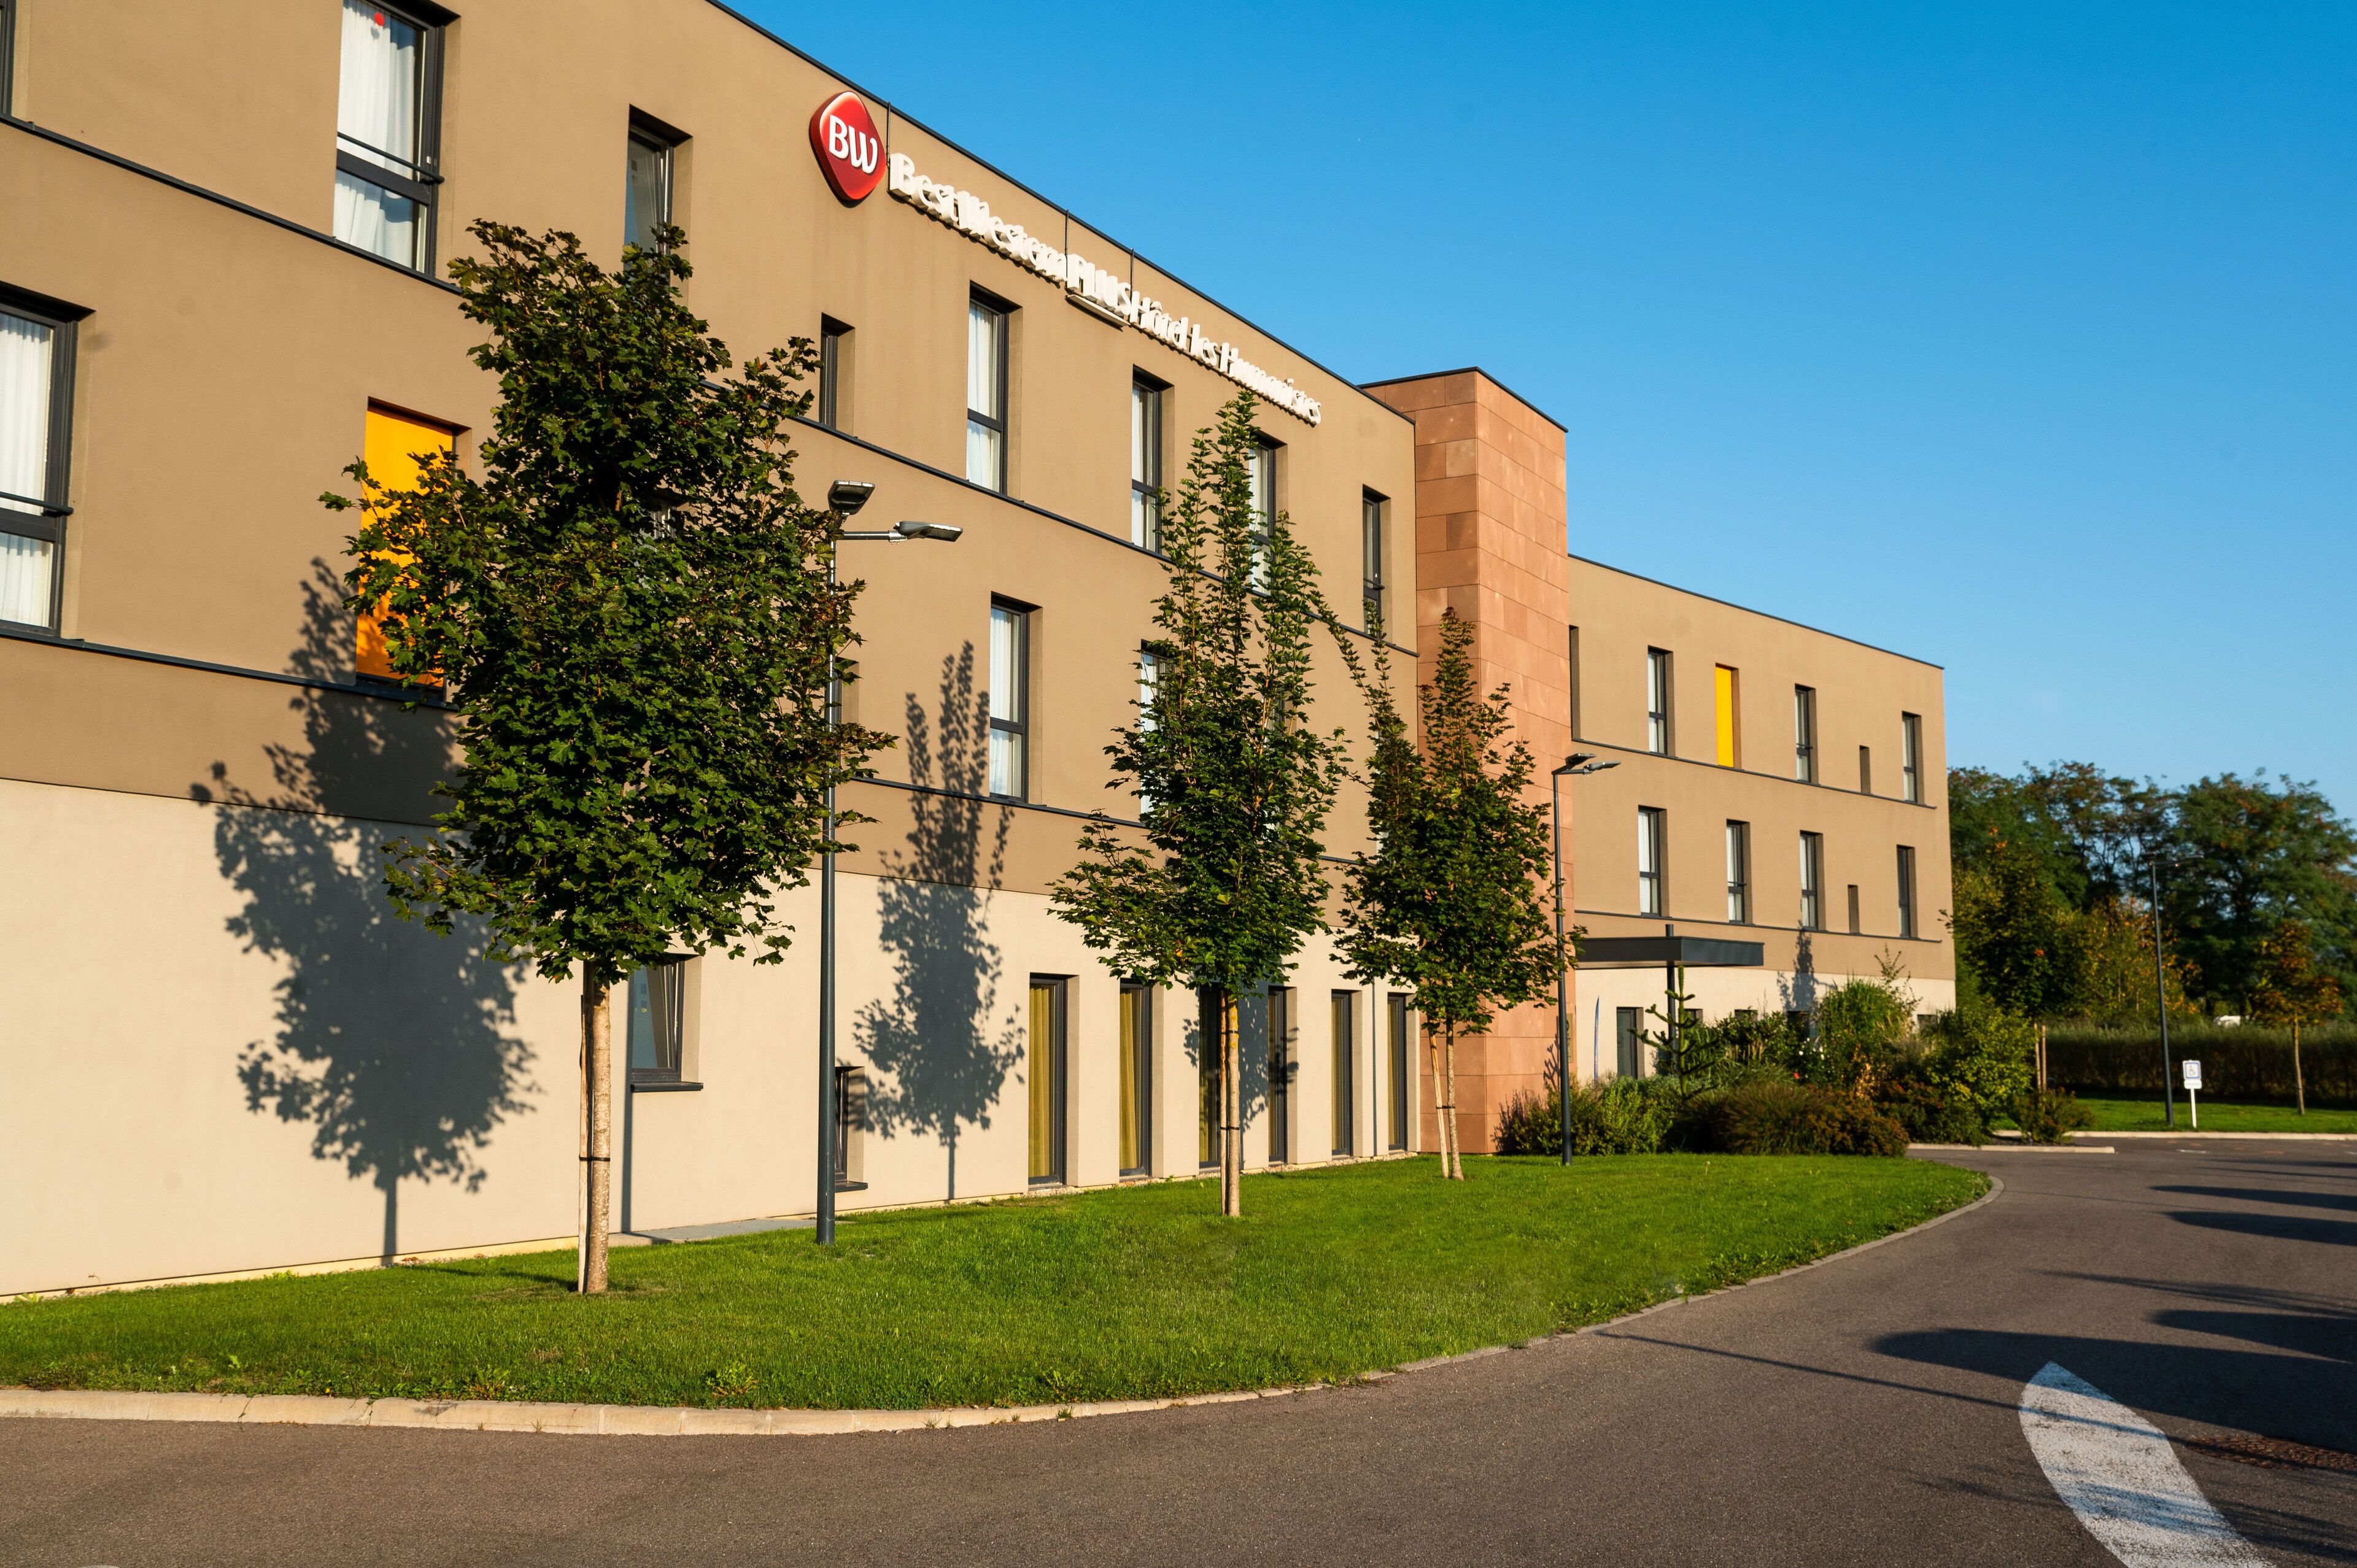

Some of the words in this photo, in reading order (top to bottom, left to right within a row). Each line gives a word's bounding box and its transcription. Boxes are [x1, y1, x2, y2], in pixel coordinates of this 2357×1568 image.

[829, 115, 878, 174] BW
[889, 153, 959, 222] Best
[956, 190, 1067, 282] Western
[1191, 323, 1218, 368] les
